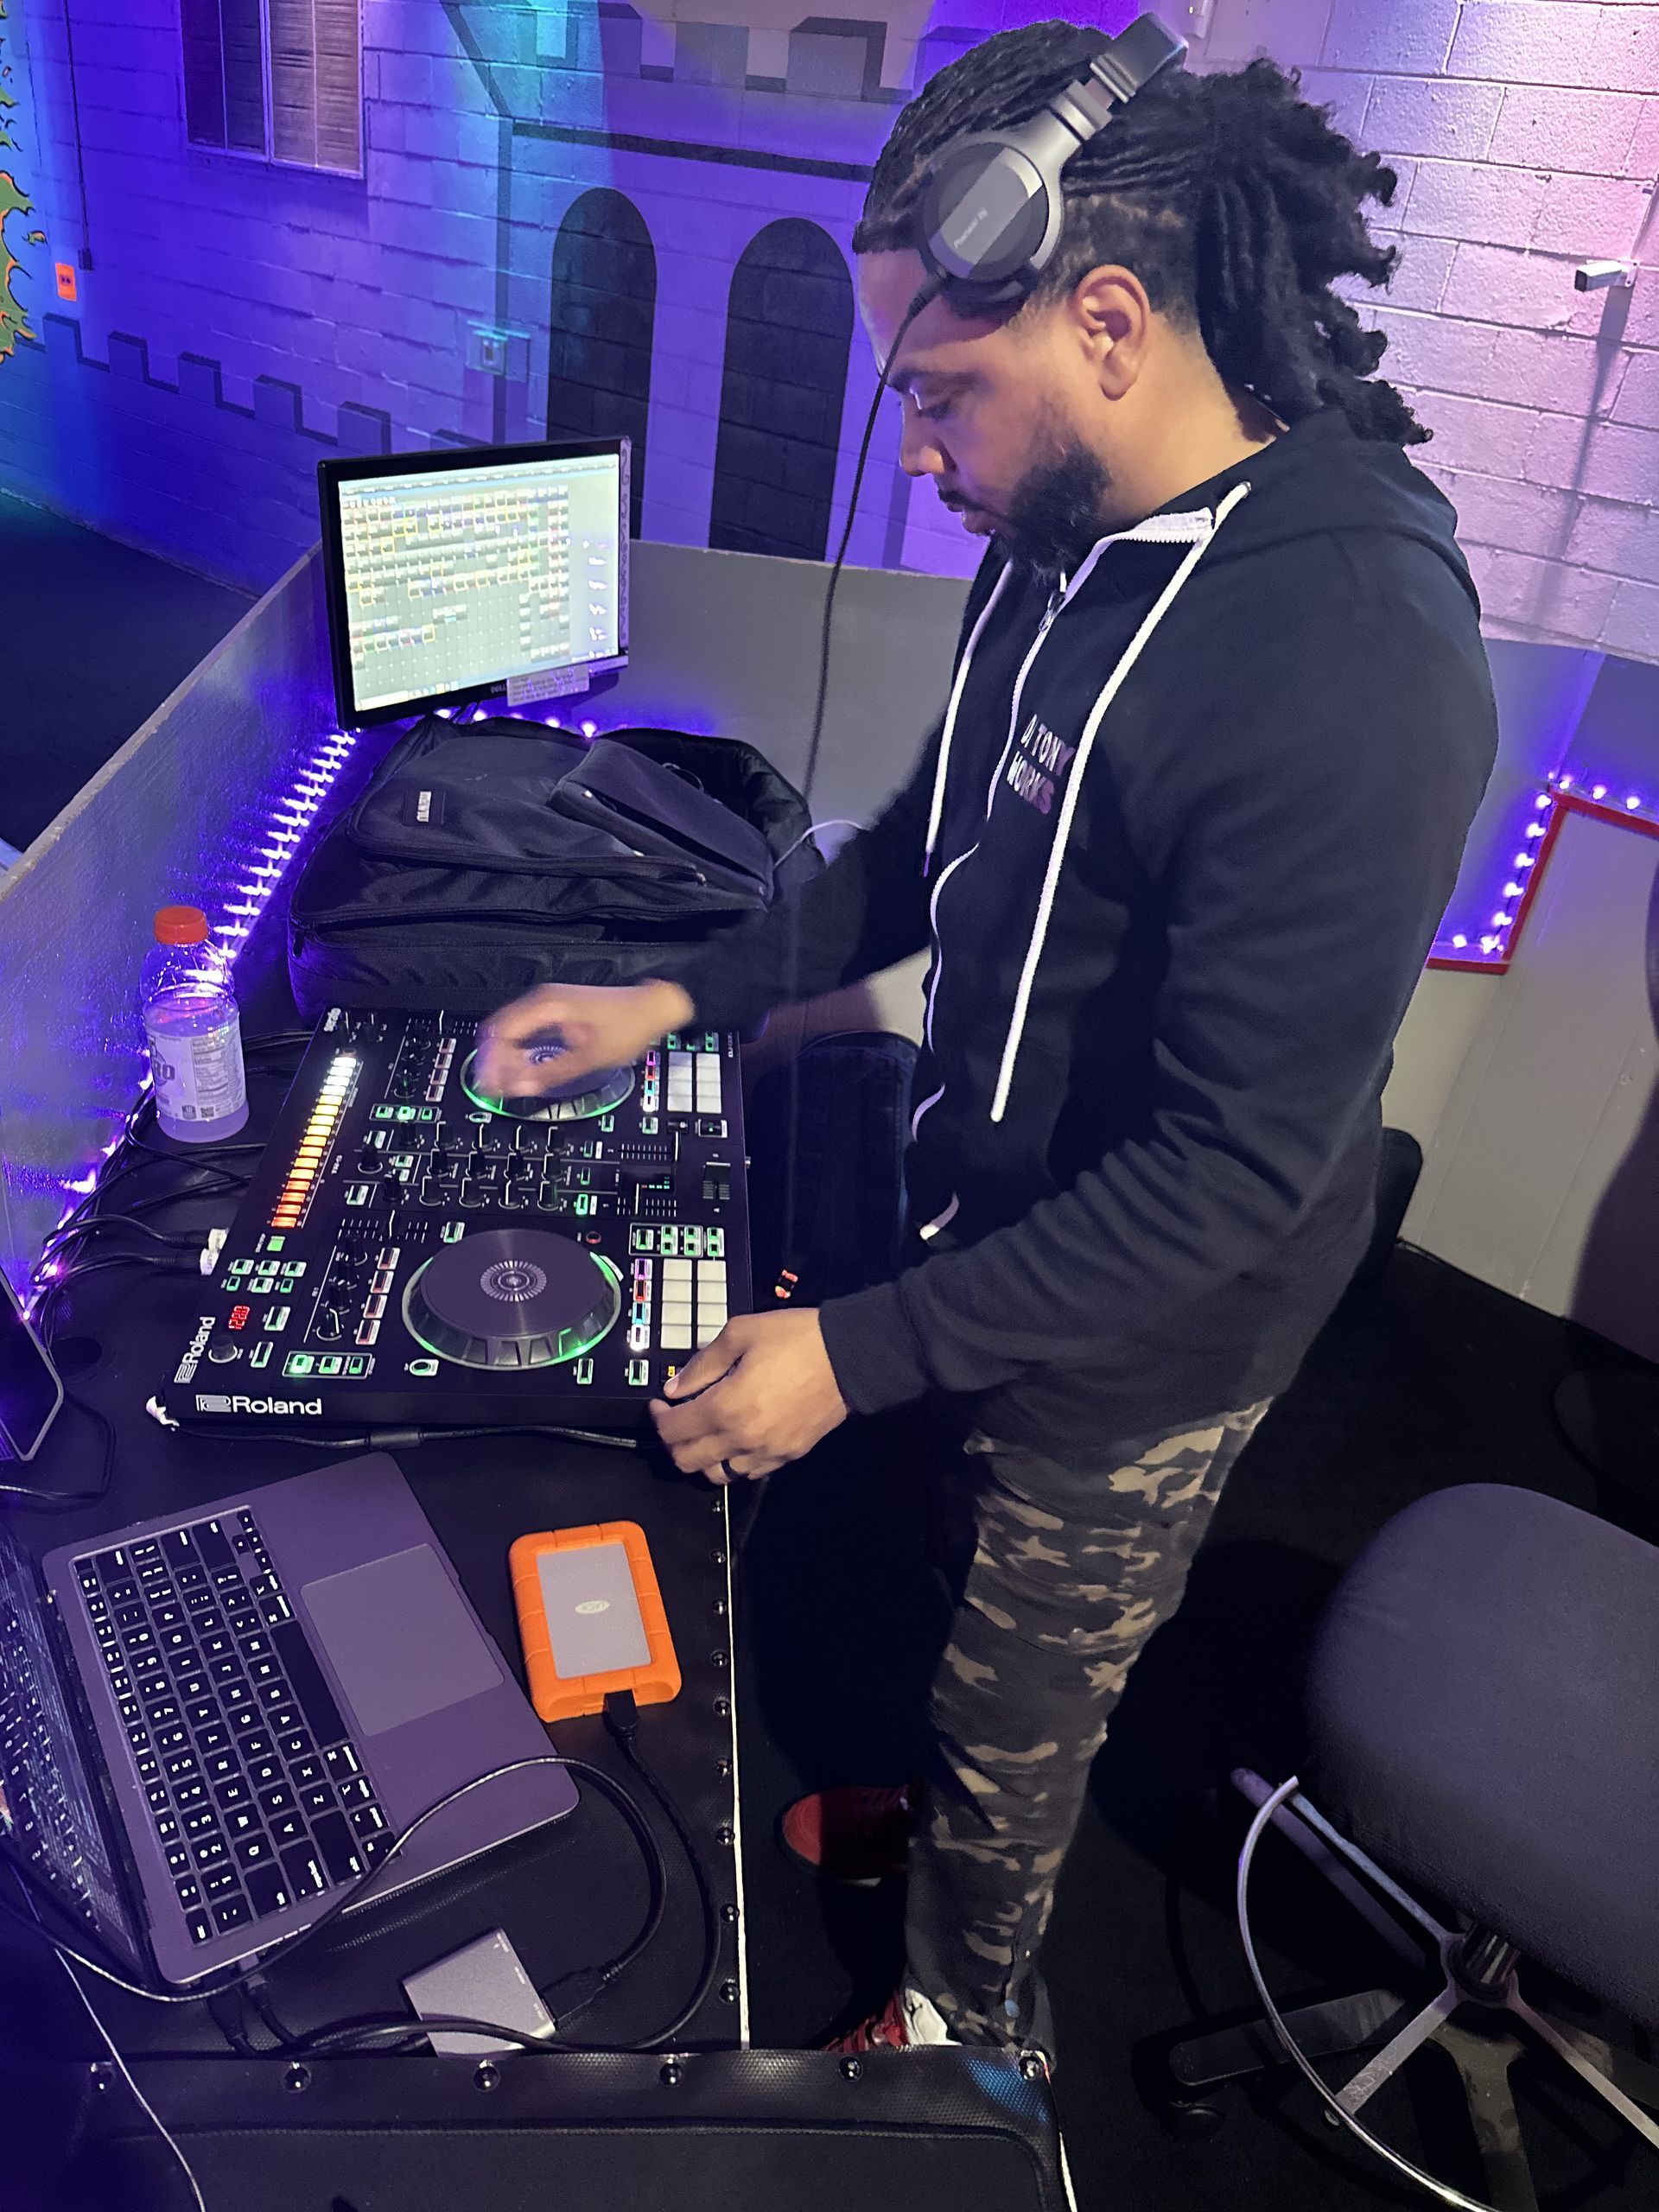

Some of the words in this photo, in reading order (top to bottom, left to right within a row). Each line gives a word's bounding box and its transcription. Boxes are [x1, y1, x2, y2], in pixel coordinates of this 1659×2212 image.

[1031, 722, 1076, 777] TONY
[182, 1316, 216, 1363] Roland
[232, 1395, 322, 1415] Roland
[213, 1641, 222, 1649] K
[173, 1732, 182, 1741] 6
[292, 1741, 301, 1750] C
[182, 1759, 192, 1768] 5
[218, 1761, 227, 1770] R
[302, 1767, 312, 1777] X
[228, 1788, 238, 1797] E
[272, 1796, 282, 1804] S
[314, 1795, 324, 1804] Z
[201, 1815, 211, 1824] 3
[283, 1823, 294, 1832] A
[211, 1844, 221, 1853] 2
[249, 1846, 259, 1856] Q
